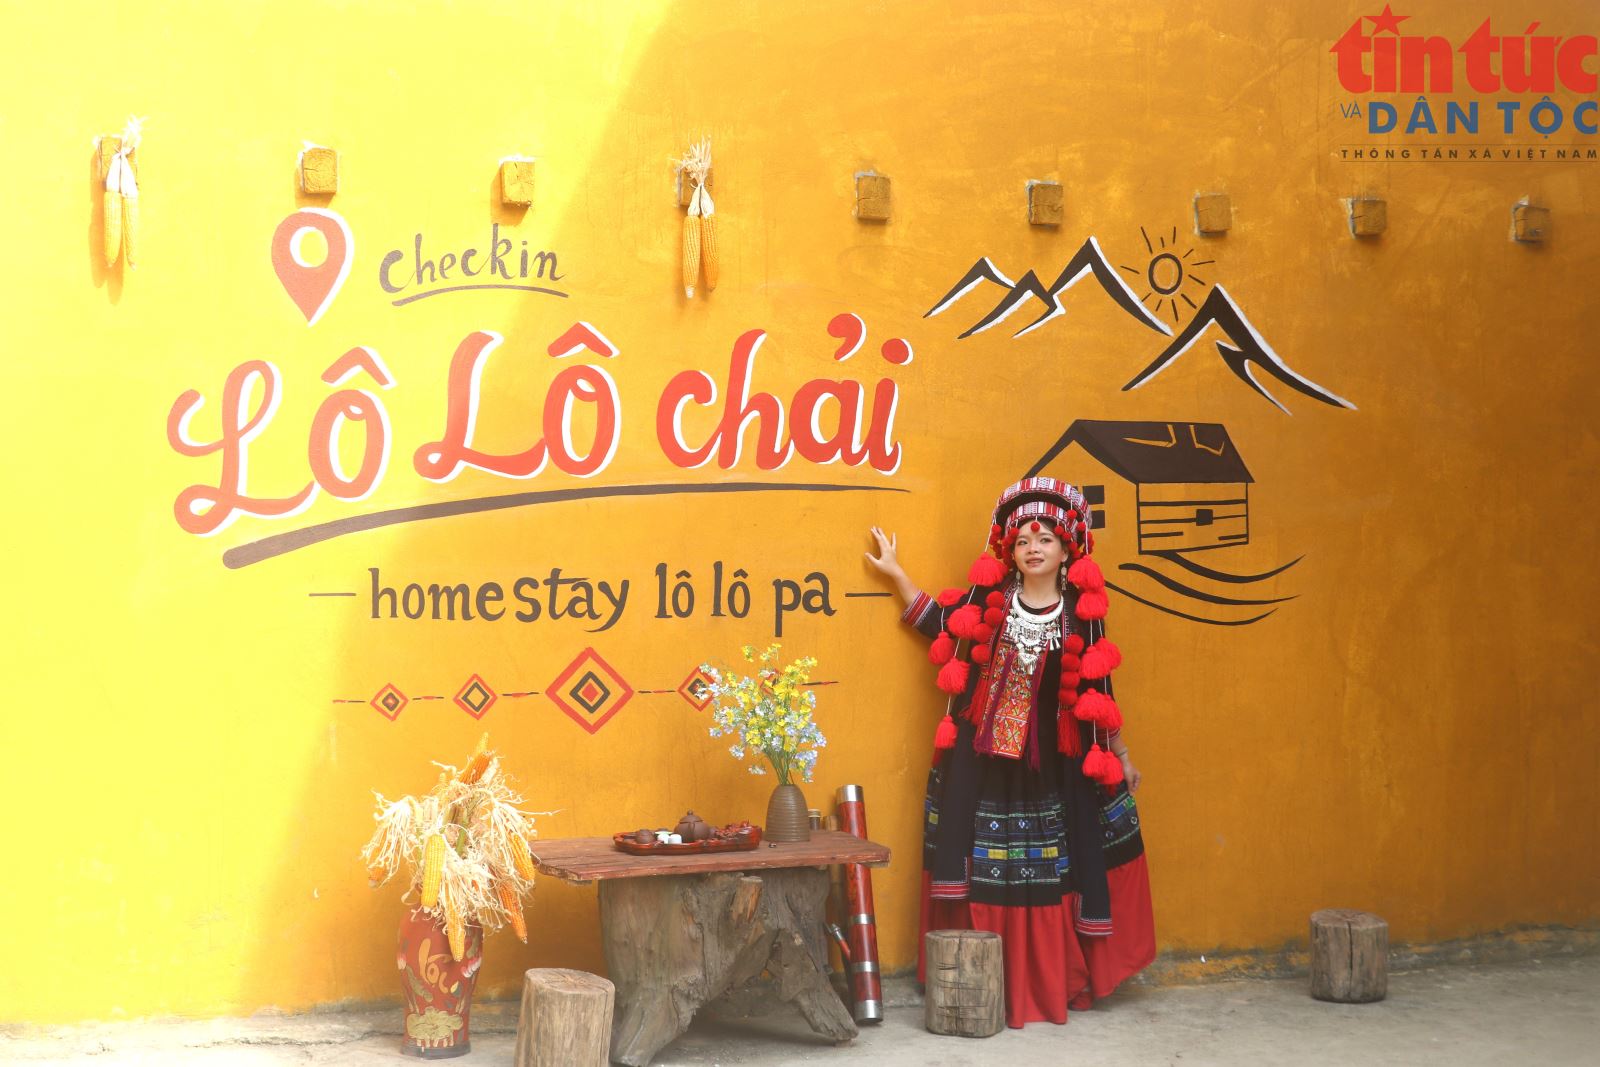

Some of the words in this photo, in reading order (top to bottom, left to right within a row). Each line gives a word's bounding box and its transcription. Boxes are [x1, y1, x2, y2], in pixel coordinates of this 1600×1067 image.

[167, 346, 398, 537] Lô
[413, 321, 620, 484] Lô
[656, 312, 913, 476] chải
[368, 567, 630, 633] homestay
[654, 562, 695, 619] lô
[710, 561, 751, 619] lô
[772, 571, 837, 638] pa
